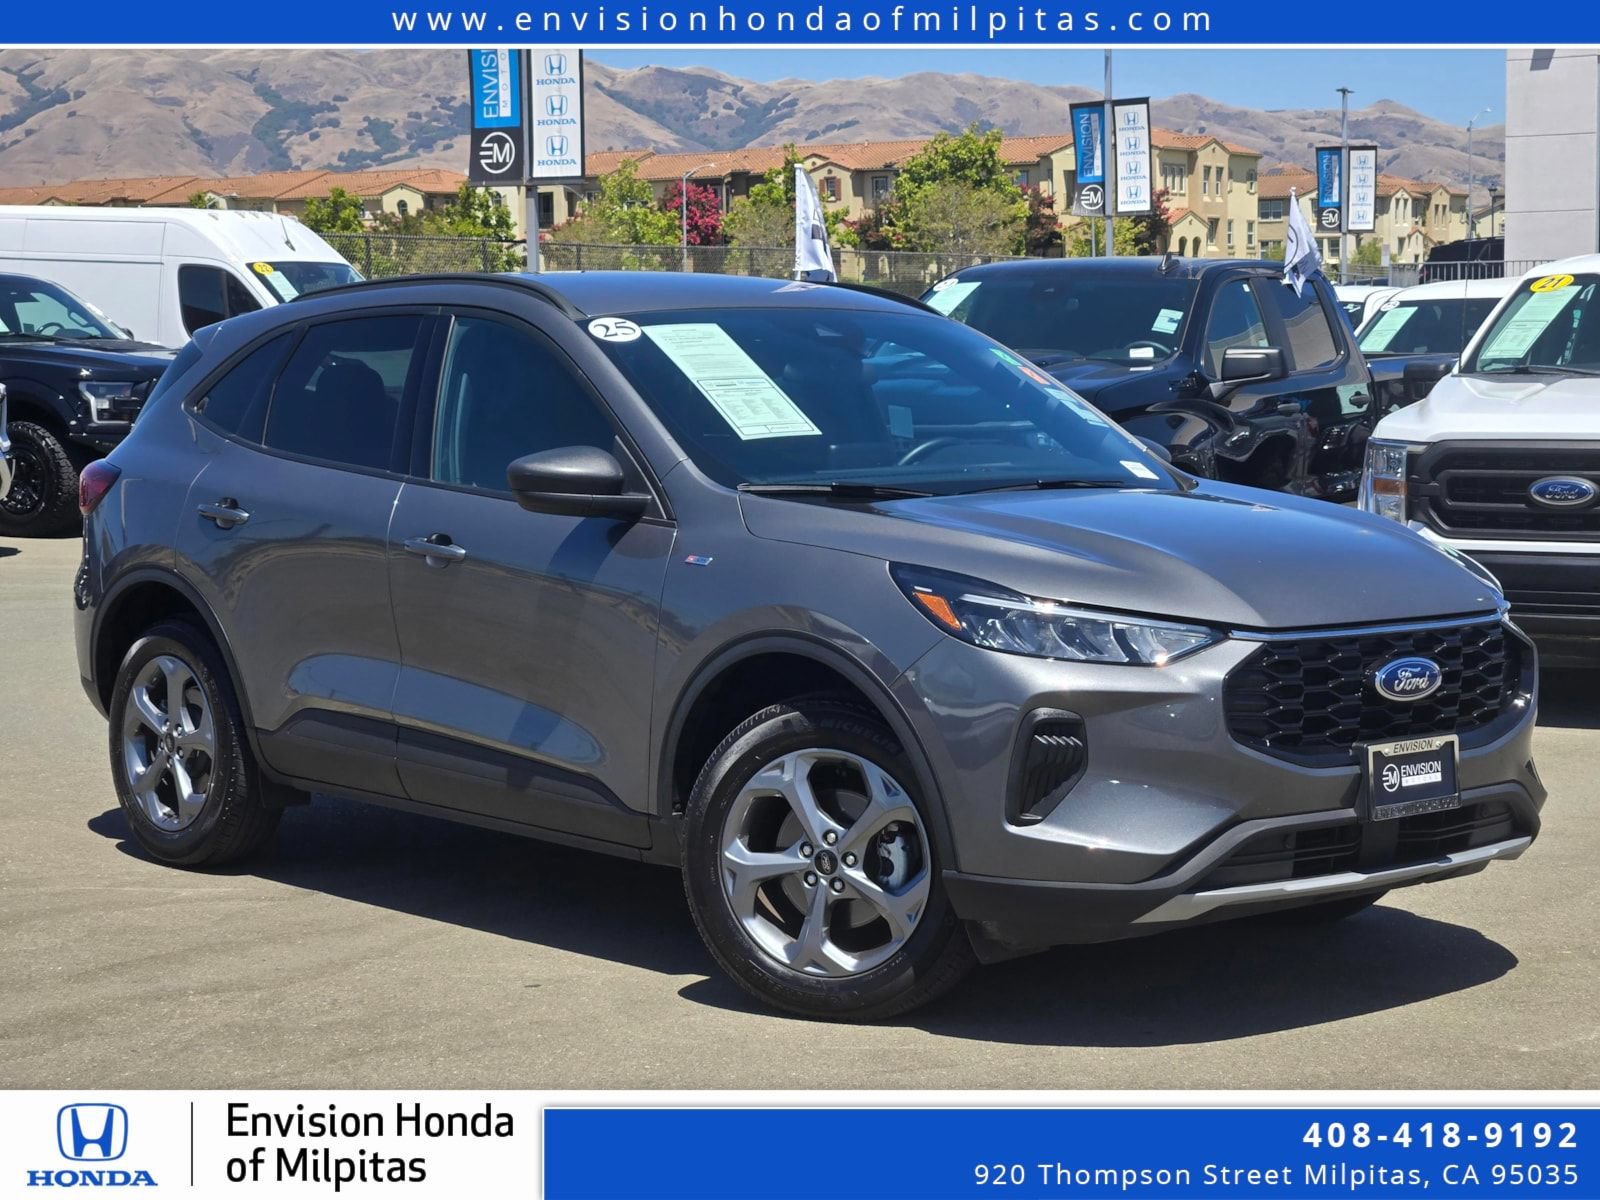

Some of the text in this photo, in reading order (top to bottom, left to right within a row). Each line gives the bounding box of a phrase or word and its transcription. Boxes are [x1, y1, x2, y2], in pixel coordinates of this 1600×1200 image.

[536, 78, 576, 86] HONDA
[537, 118, 577, 126] HONDA
[1079, 113, 1095, 177] ENVISION
[537, 159, 577, 167] HONDA
[593, 320, 637, 338] 25
[1545, 484, 1579, 499] Ford
[1394, 667, 1431, 691] Ford
[1393, 740, 1434, 754] ENVISION
[1401, 760, 1442, 777] ENVISION
